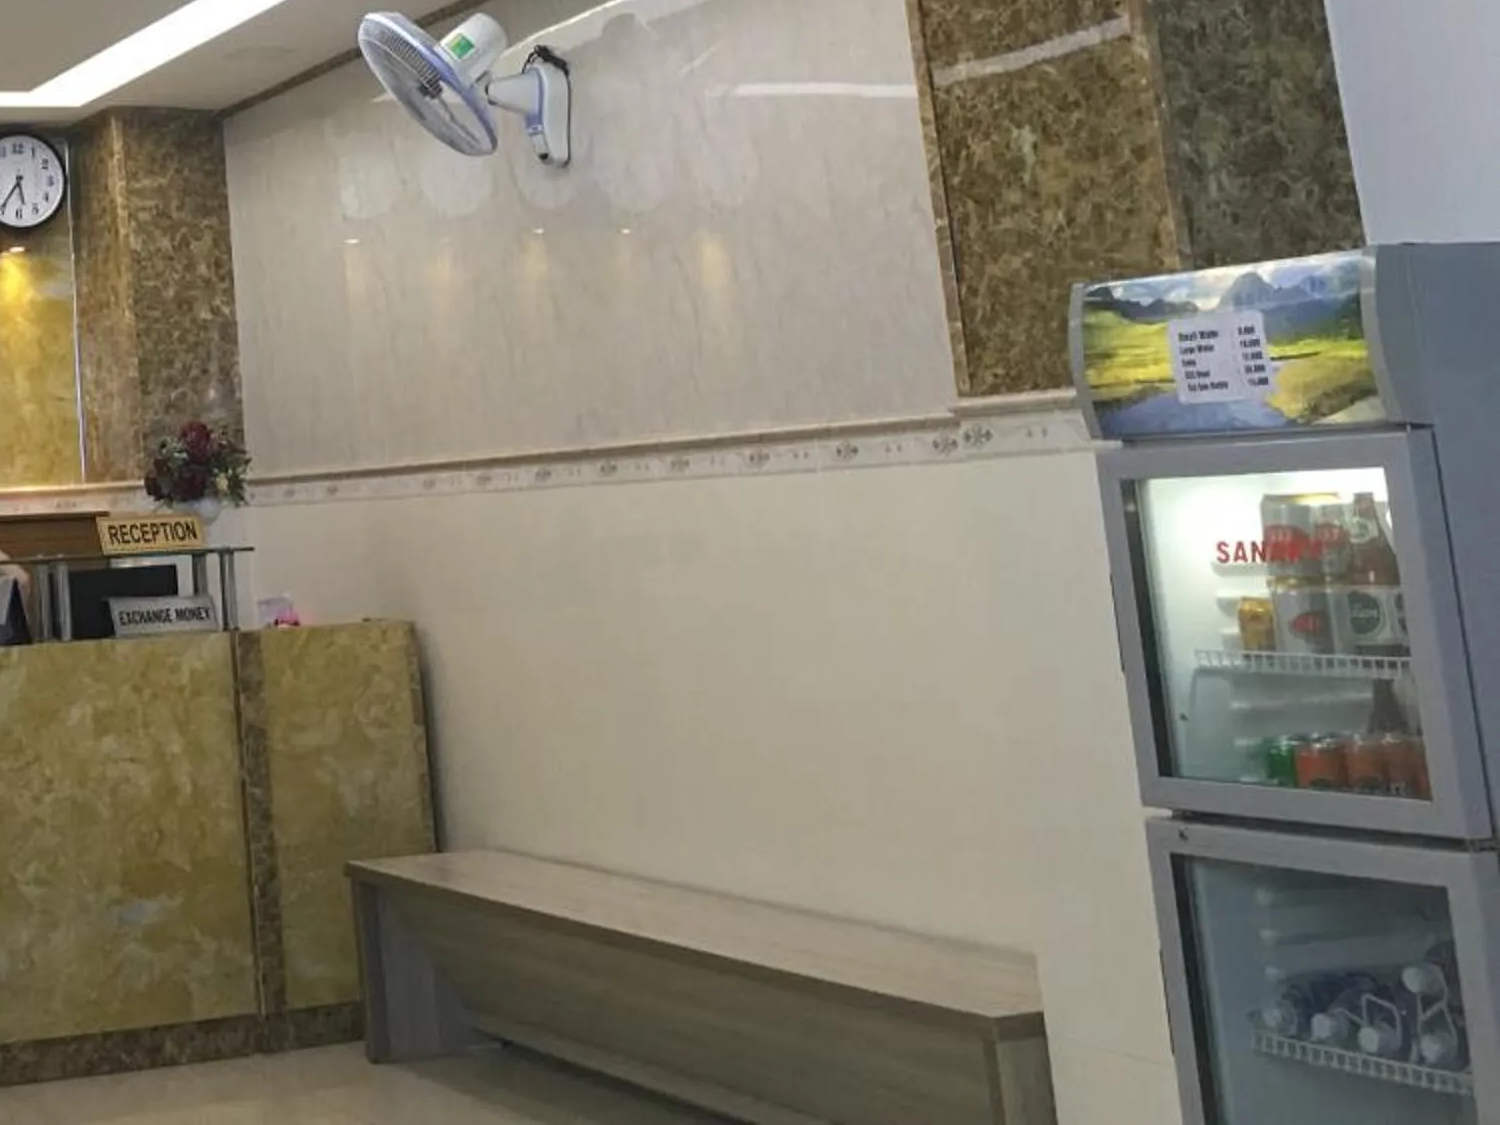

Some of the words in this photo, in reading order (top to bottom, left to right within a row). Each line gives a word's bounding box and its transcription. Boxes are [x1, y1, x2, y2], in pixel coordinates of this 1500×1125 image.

[12, 143, 24, 154] 12
[108, 521, 198, 545] RECEPTION
[120, 608, 172, 626] EXCHANGE
[175, 606, 211, 622] MONEY
